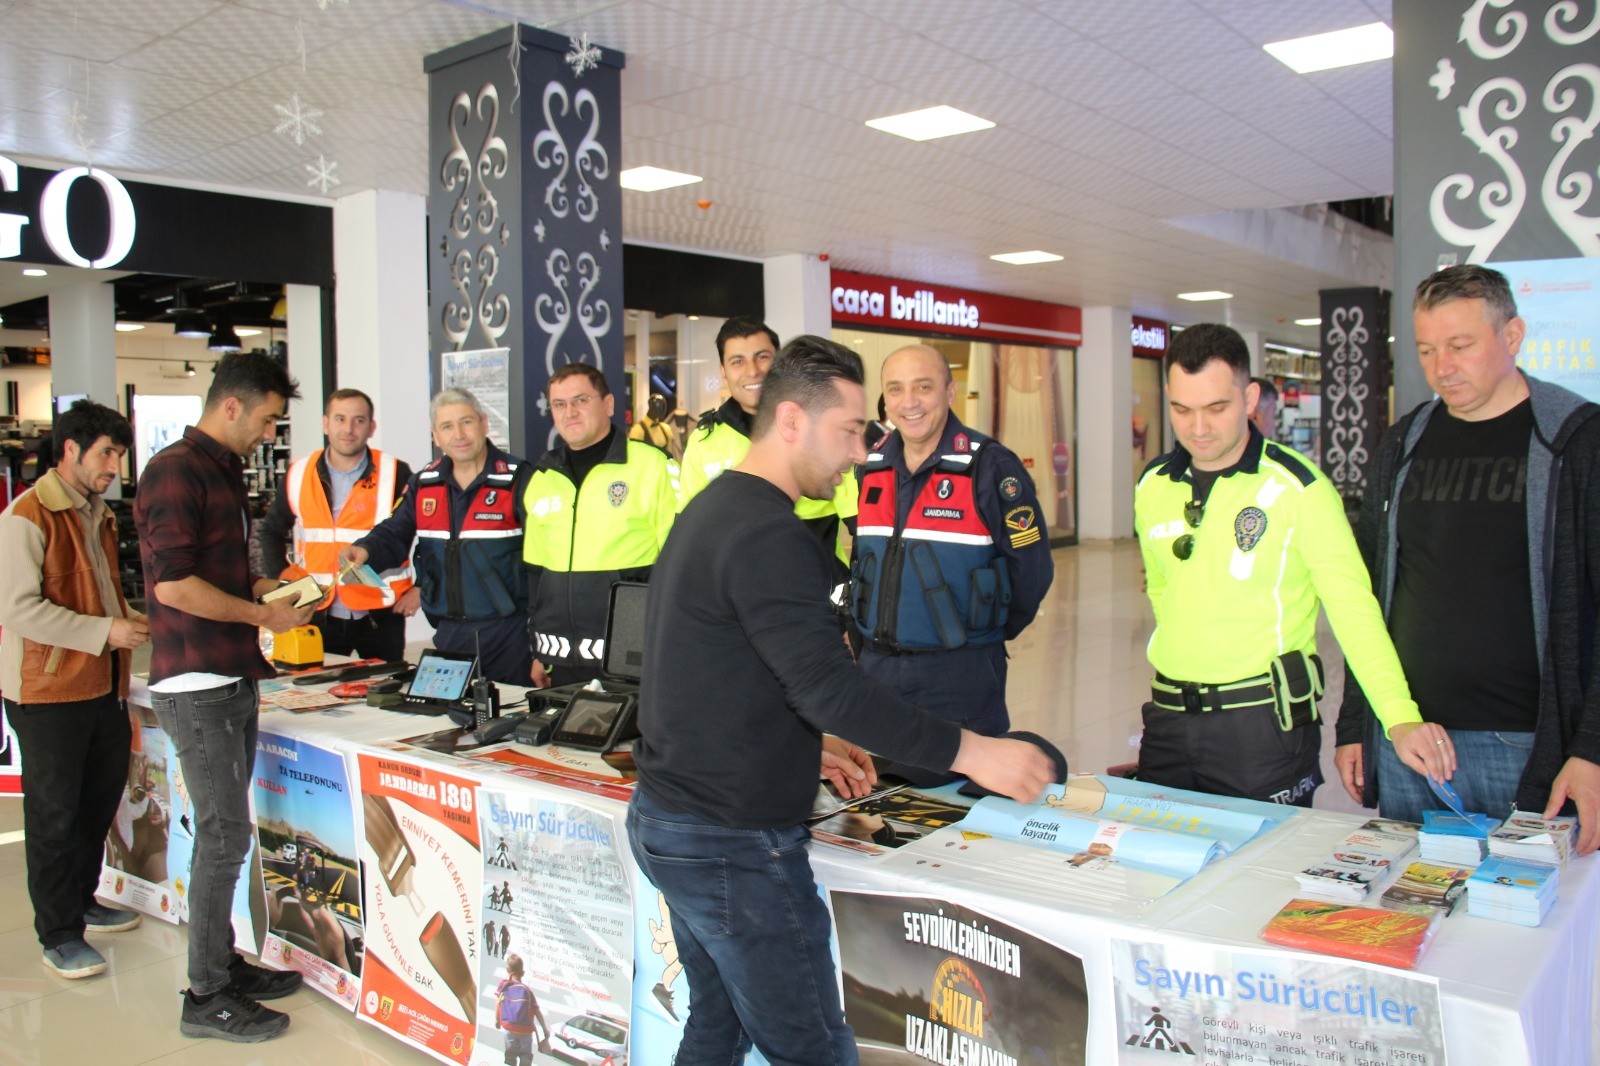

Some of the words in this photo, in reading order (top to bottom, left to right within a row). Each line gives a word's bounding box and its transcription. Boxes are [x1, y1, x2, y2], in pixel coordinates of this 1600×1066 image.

[832, 286, 884, 316] casa
[890, 286, 979, 328] brillante
[1129, 323, 1165, 350] ekstili
[924, 508, 961, 519] JANDARMA
[266, 744, 298, 761] ARACINI
[258, 778, 287, 795] KULLAN
[289, 770, 342, 792] TELEFONUNU
[380, 772, 436, 800] JANDARMA
[440, 780, 472, 812] 180
[491, 804, 534, 830] Sayın
[538, 812, 611, 847] Sürücüler
[1020, 826, 1056, 842] hayatın
[1026, 818, 1060, 832] öncelik
[402, 816, 442, 853] EMNİYET
[441, 852, 474, 924] KEMERİNİ
[468, 930, 476, 959] TAK
[374, 884, 386, 920] YOLA
[383, 924, 412, 976] GÜVENLE
[414, 972, 434, 990] BAK
[903, 908, 1020, 978] SEVDİKLERİNİZDEN
[1134, 958, 1225, 998] Sayın
[1237, 970, 1419, 1026] Sürücüler
[942, 986, 984, 1038] HIZLA
[1202, 1016, 1239, 1031] Görevli
[1249, 1022, 1266, 1036] kişi
[1277, 1028, 1302, 1041] veya
[1313, 1034, 1338, 1046] ışıklı
[1349, 1040, 1378, 1054] trafik
[1390, 1046, 1426, 1064] işareti
[1203, 1032, 1267, 1050] bulunmayan
[1276, 1043, 1307, 1056] ancak
[1316, 1049, 1345, 1062] trafik
[1204, 1046, 1254, 1062] levhalarla
